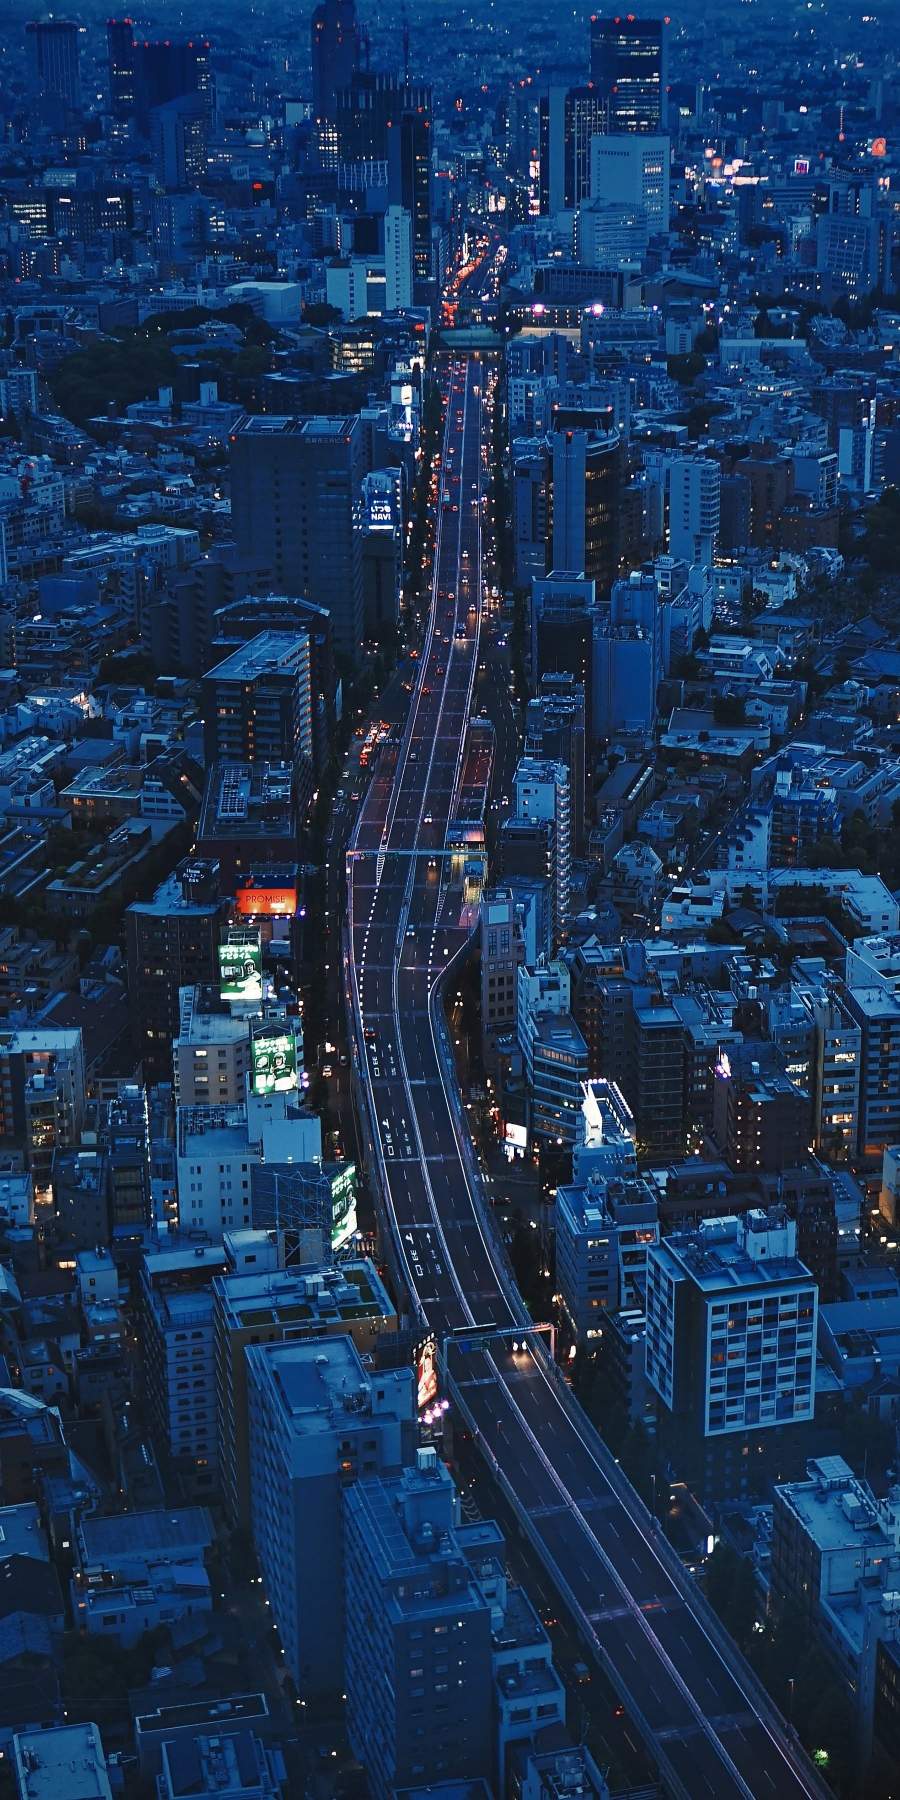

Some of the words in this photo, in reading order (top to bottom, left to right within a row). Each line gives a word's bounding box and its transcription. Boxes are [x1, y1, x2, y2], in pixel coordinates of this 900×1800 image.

[371, 513, 391, 521] NAVI
[245, 895, 286, 904] PROMISE
[219, 952, 252, 960] ナビタイム
